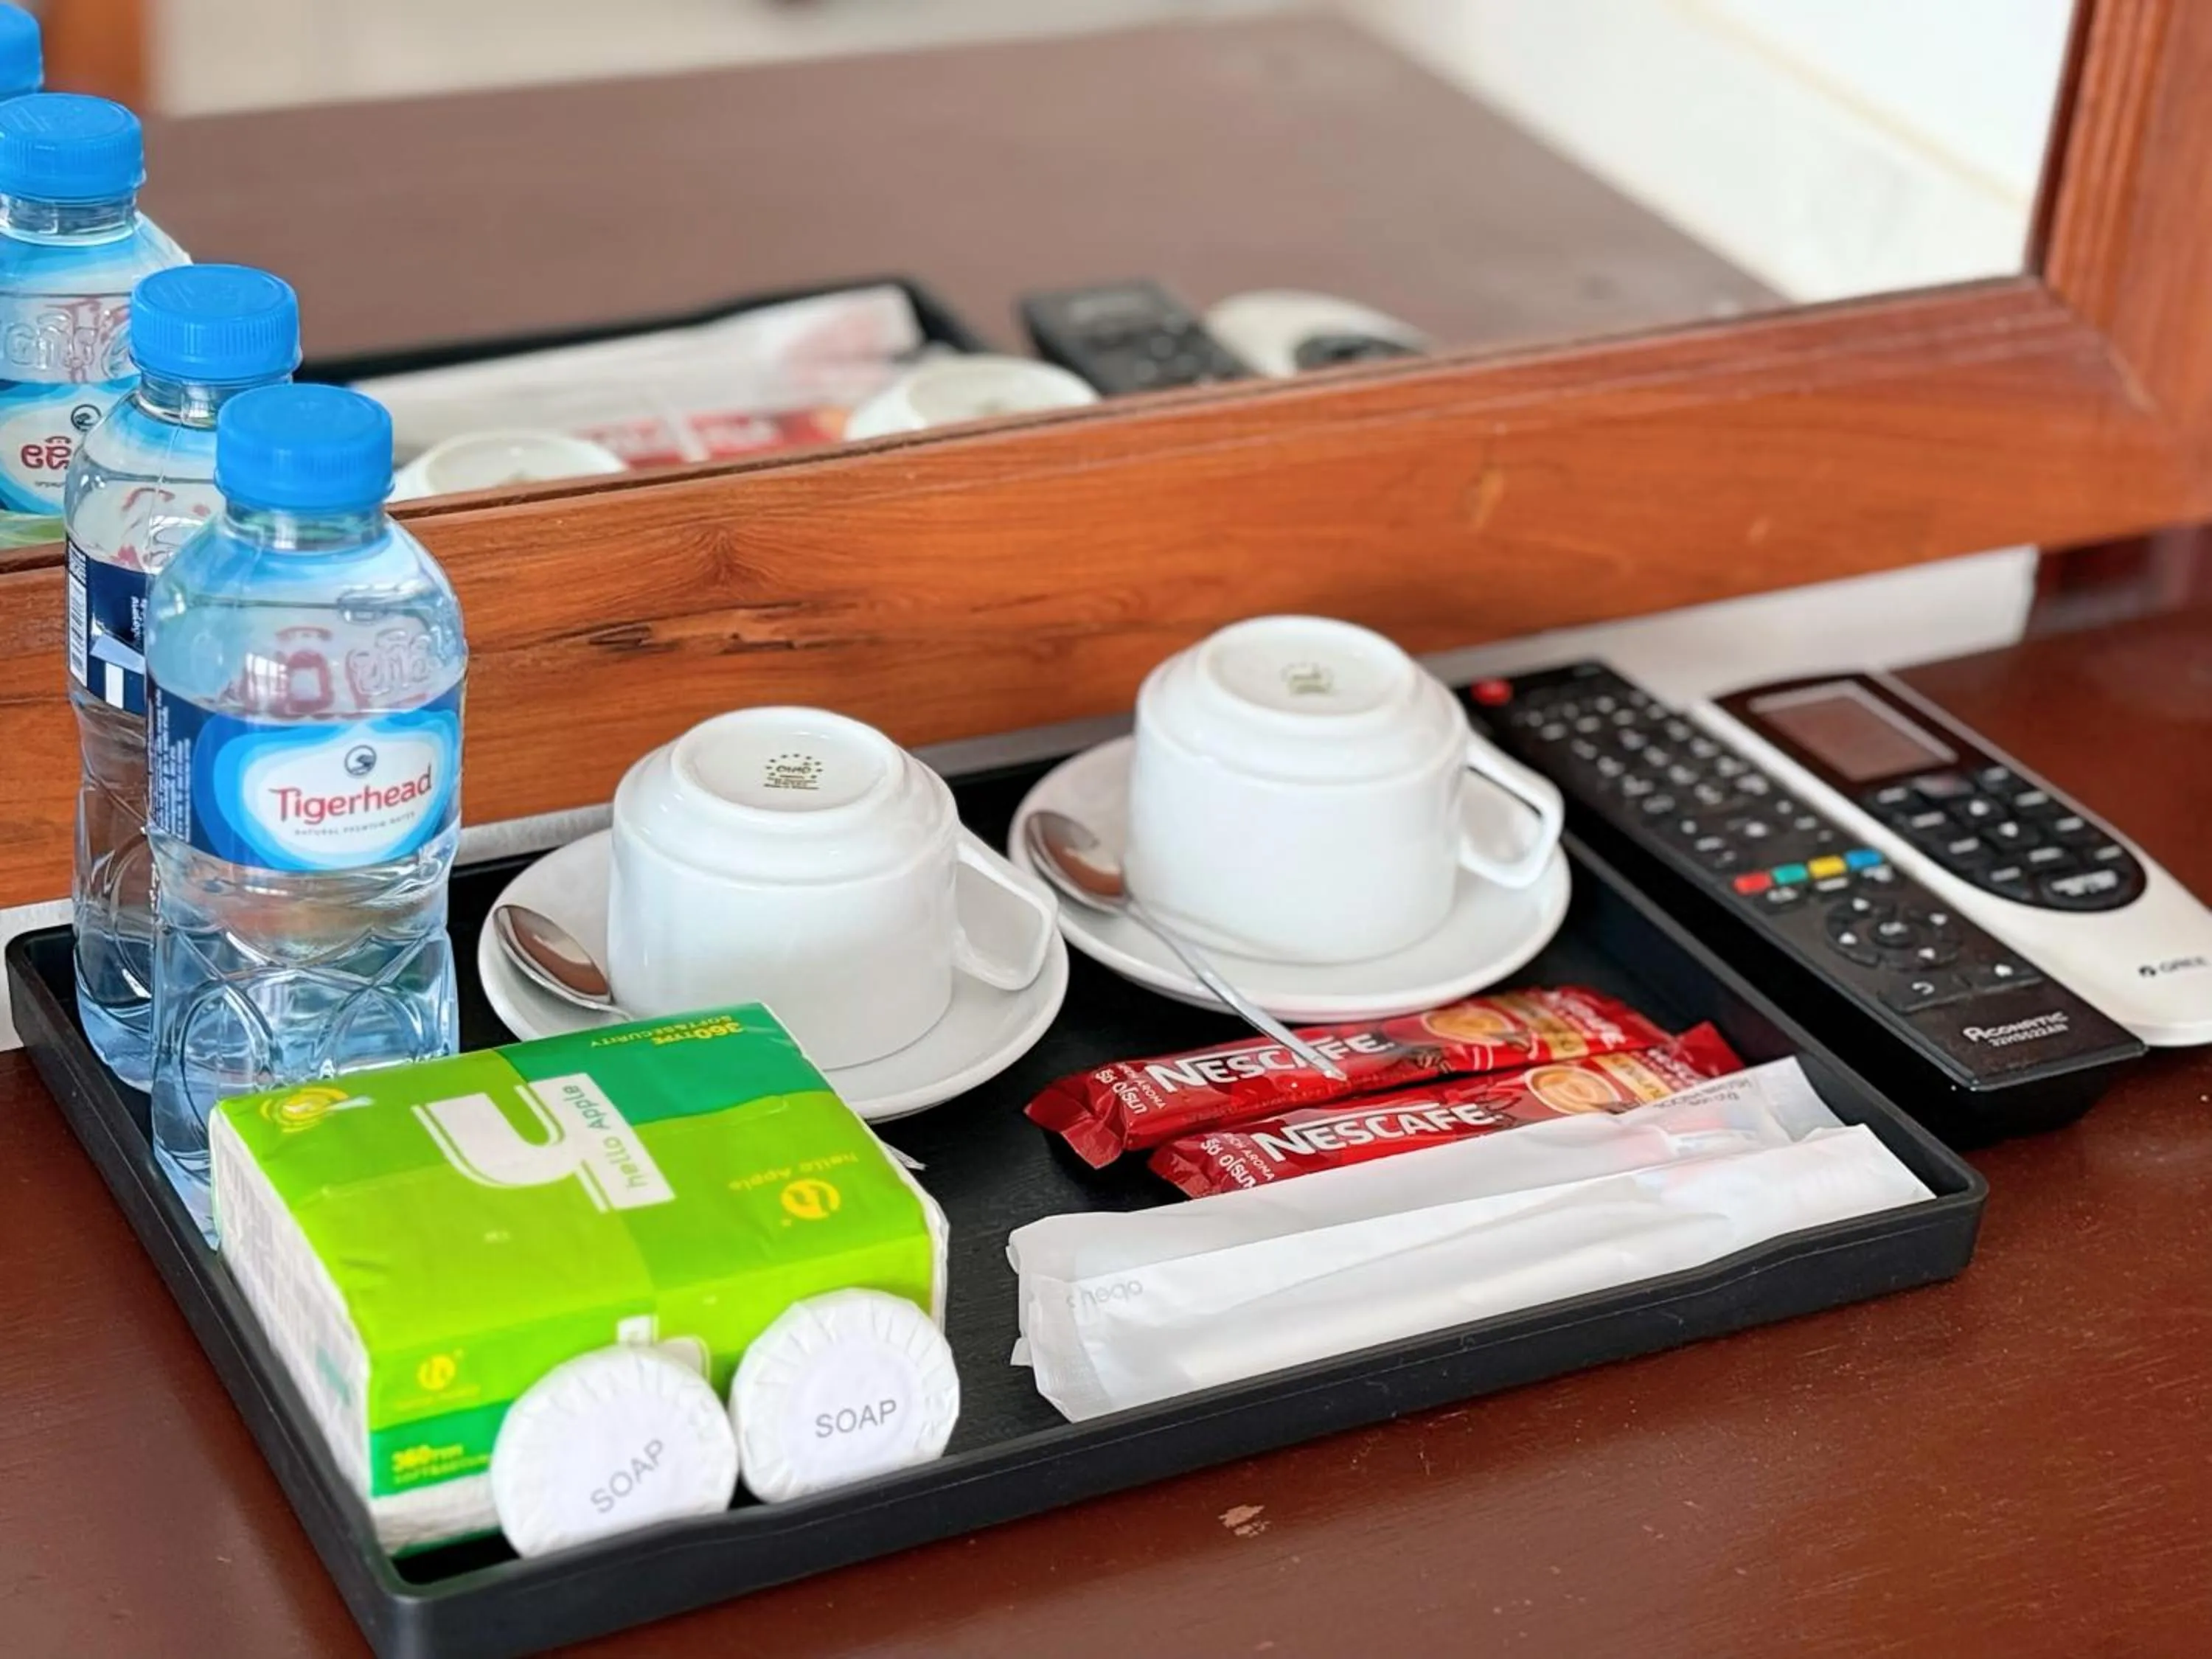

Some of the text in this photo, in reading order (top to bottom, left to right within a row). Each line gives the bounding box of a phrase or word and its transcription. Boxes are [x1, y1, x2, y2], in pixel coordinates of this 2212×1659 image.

[268, 762, 432, 825] Tigerhead
[1134, 1079, 1166, 1110] AROMA
[562, 1084, 650, 1189] hello Apple
[1241, 1149, 1276, 1181] AROMA
[815, 1399, 897, 1439] SOAP
[590, 1439, 665, 1514] SOAP
